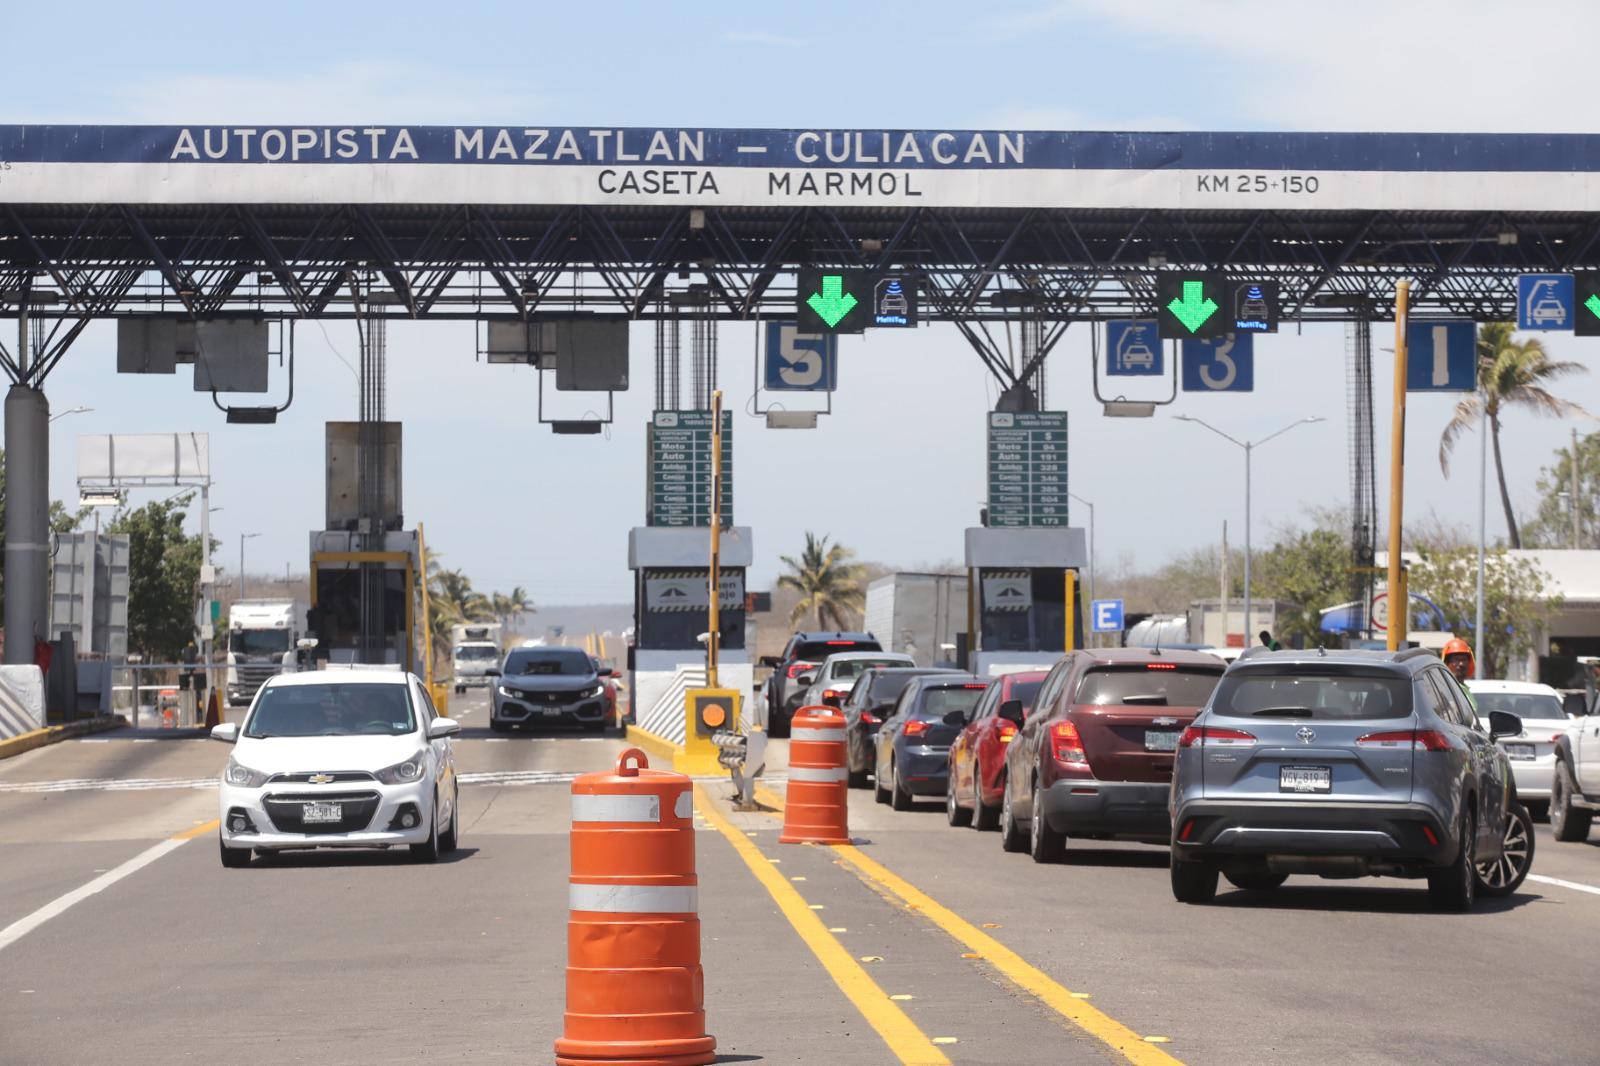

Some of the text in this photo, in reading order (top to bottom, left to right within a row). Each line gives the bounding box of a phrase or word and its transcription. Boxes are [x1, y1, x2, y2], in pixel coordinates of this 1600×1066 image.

[170, 128, 419, 161] AUTOPISTA
[454, 128, 704, 161] MAZATLAN
[795, 131, 1025, 164] CULIACAN
[598, 169, 923, 196] CASETA MARMOL
[1197, 175, 1319, 193] KM 25+150
[779, 326, 823, 386] 5
[1200, 333, 1236, 390] 3
[1431, 326, 1449, 386] 1
[662, 452, 684, 460] Auto
[1098, 603, 1118, 628] E
